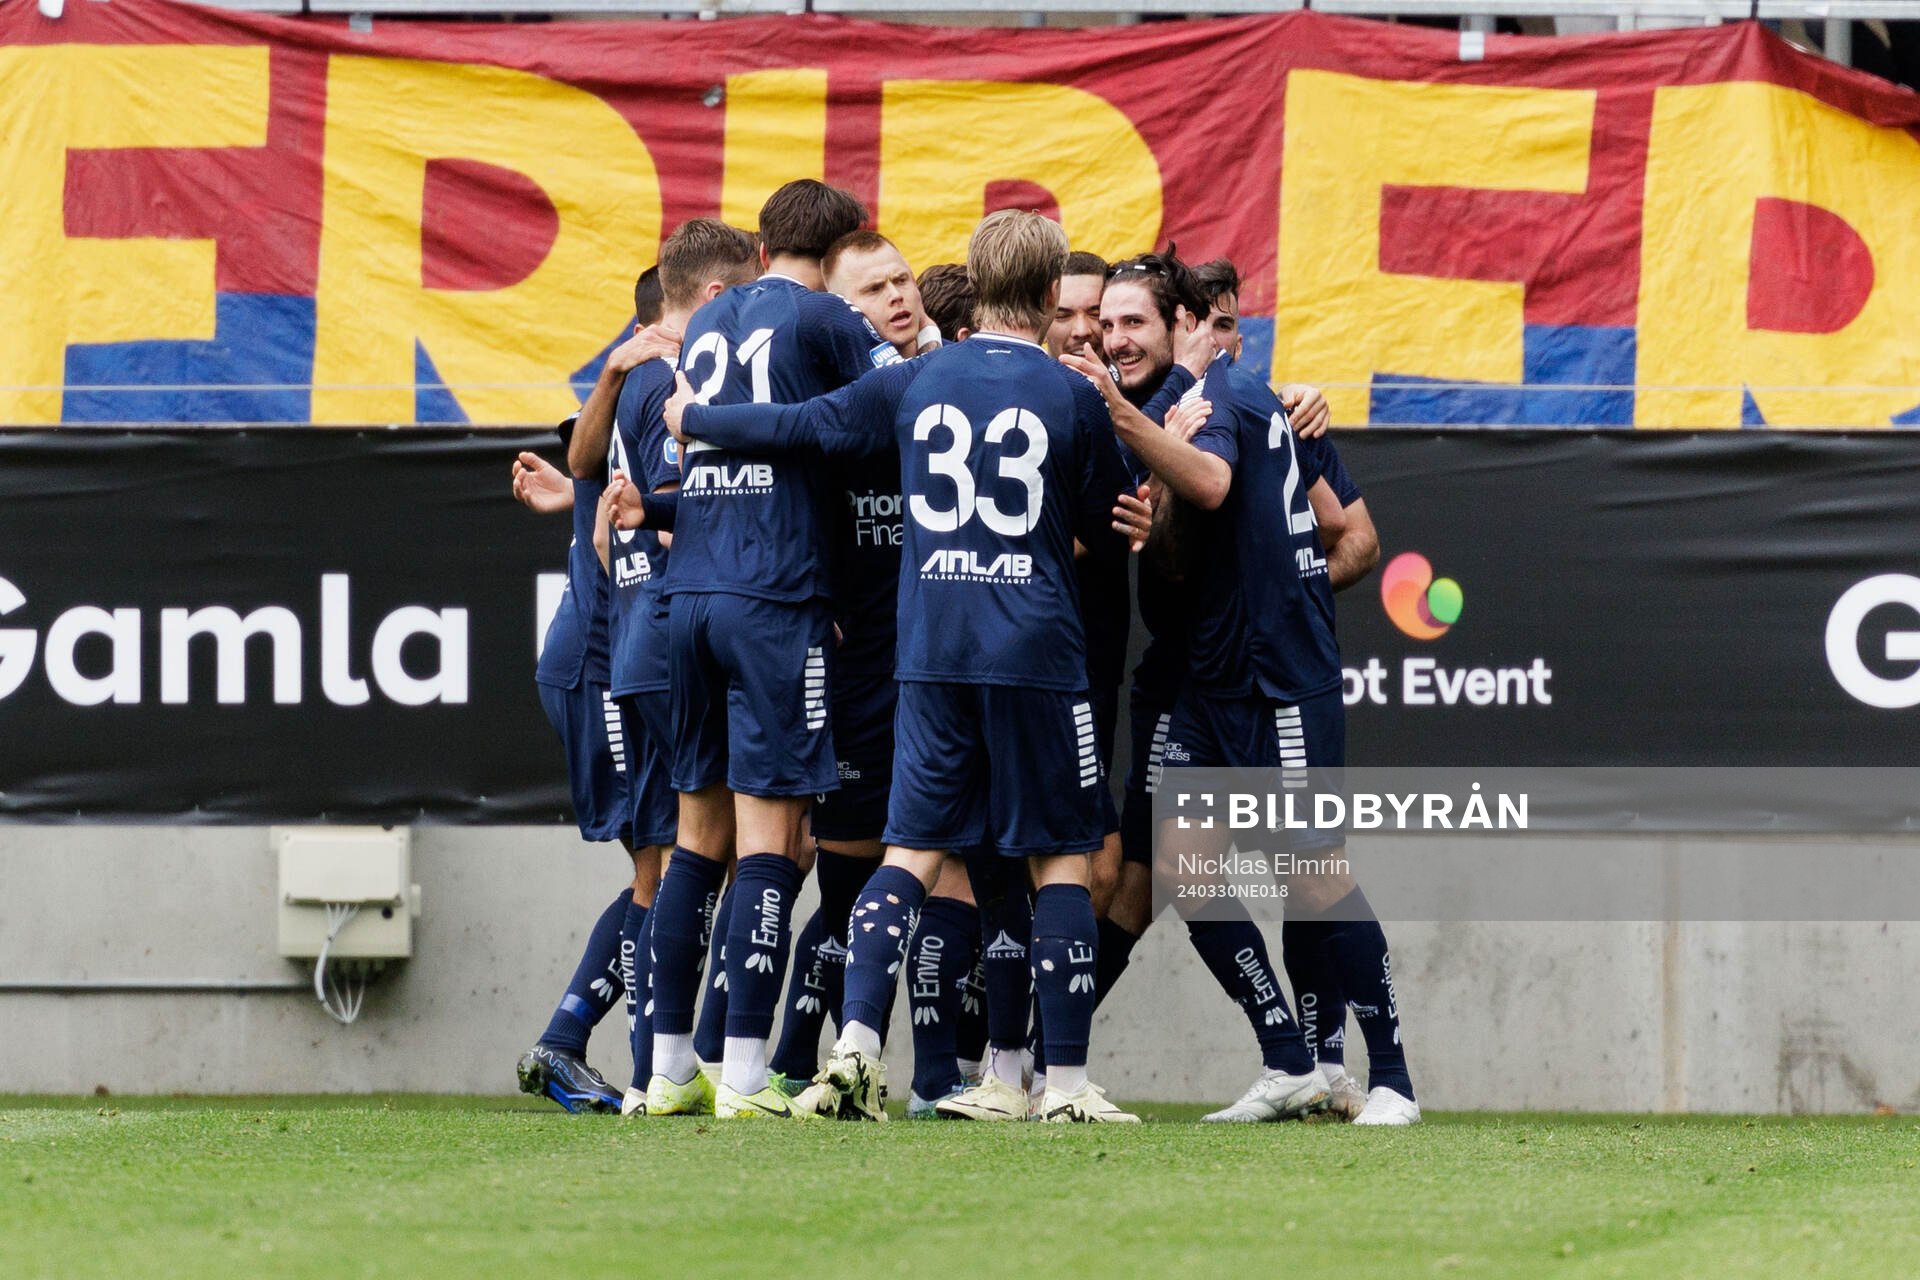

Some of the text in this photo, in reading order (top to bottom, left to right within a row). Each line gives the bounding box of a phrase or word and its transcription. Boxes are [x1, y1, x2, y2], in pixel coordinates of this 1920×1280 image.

[682, 464, 774, 490] ANLAB
[909, 403, 1049, 536] 33
[920, 549, 1033, 577] ANLAB
[0, 572, 469, 706] amla
[1824, 573, 1920, 709] G
[1402, 657, 1553, 706] Event
[751, 888, 781, 948] Enviro
[913, 935, 944, 998] Enviro
[1235, 947, 1276, 1005] Enviro
